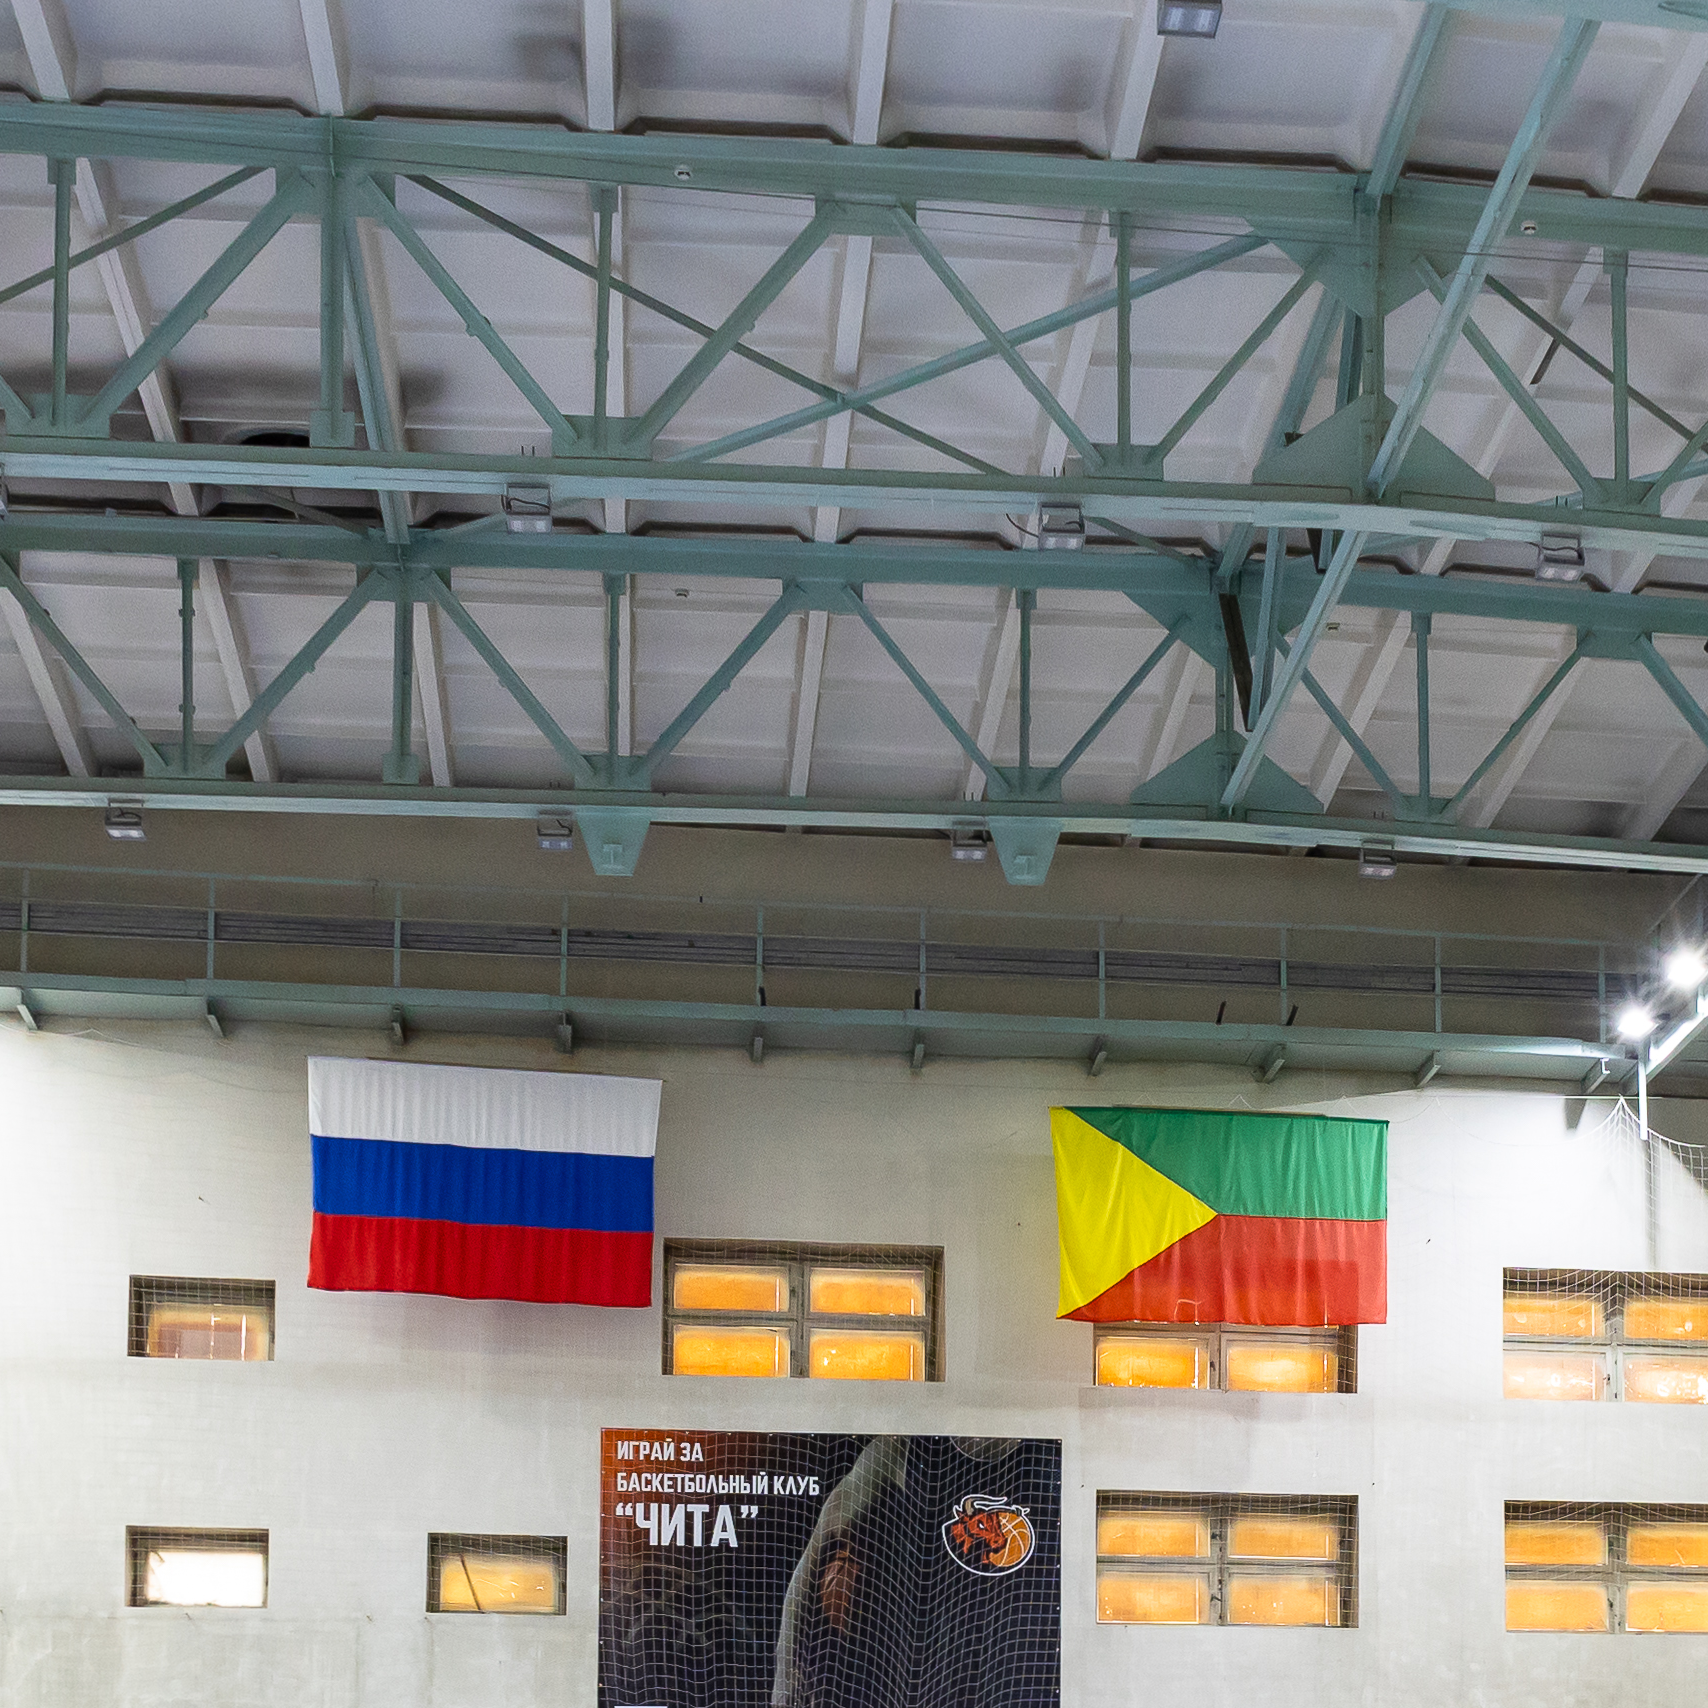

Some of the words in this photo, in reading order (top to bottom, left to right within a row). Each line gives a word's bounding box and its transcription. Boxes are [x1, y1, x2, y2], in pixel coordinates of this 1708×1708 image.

[617, 1438, 675, 1461] ИГРАЙ
[679, 1442, 704, 1462] ЗА
[616, 1471, 769, 1495] БАСКЕТБОЛЬНЫЙ
[773, 1475, 820, 1496] КЛУБ
